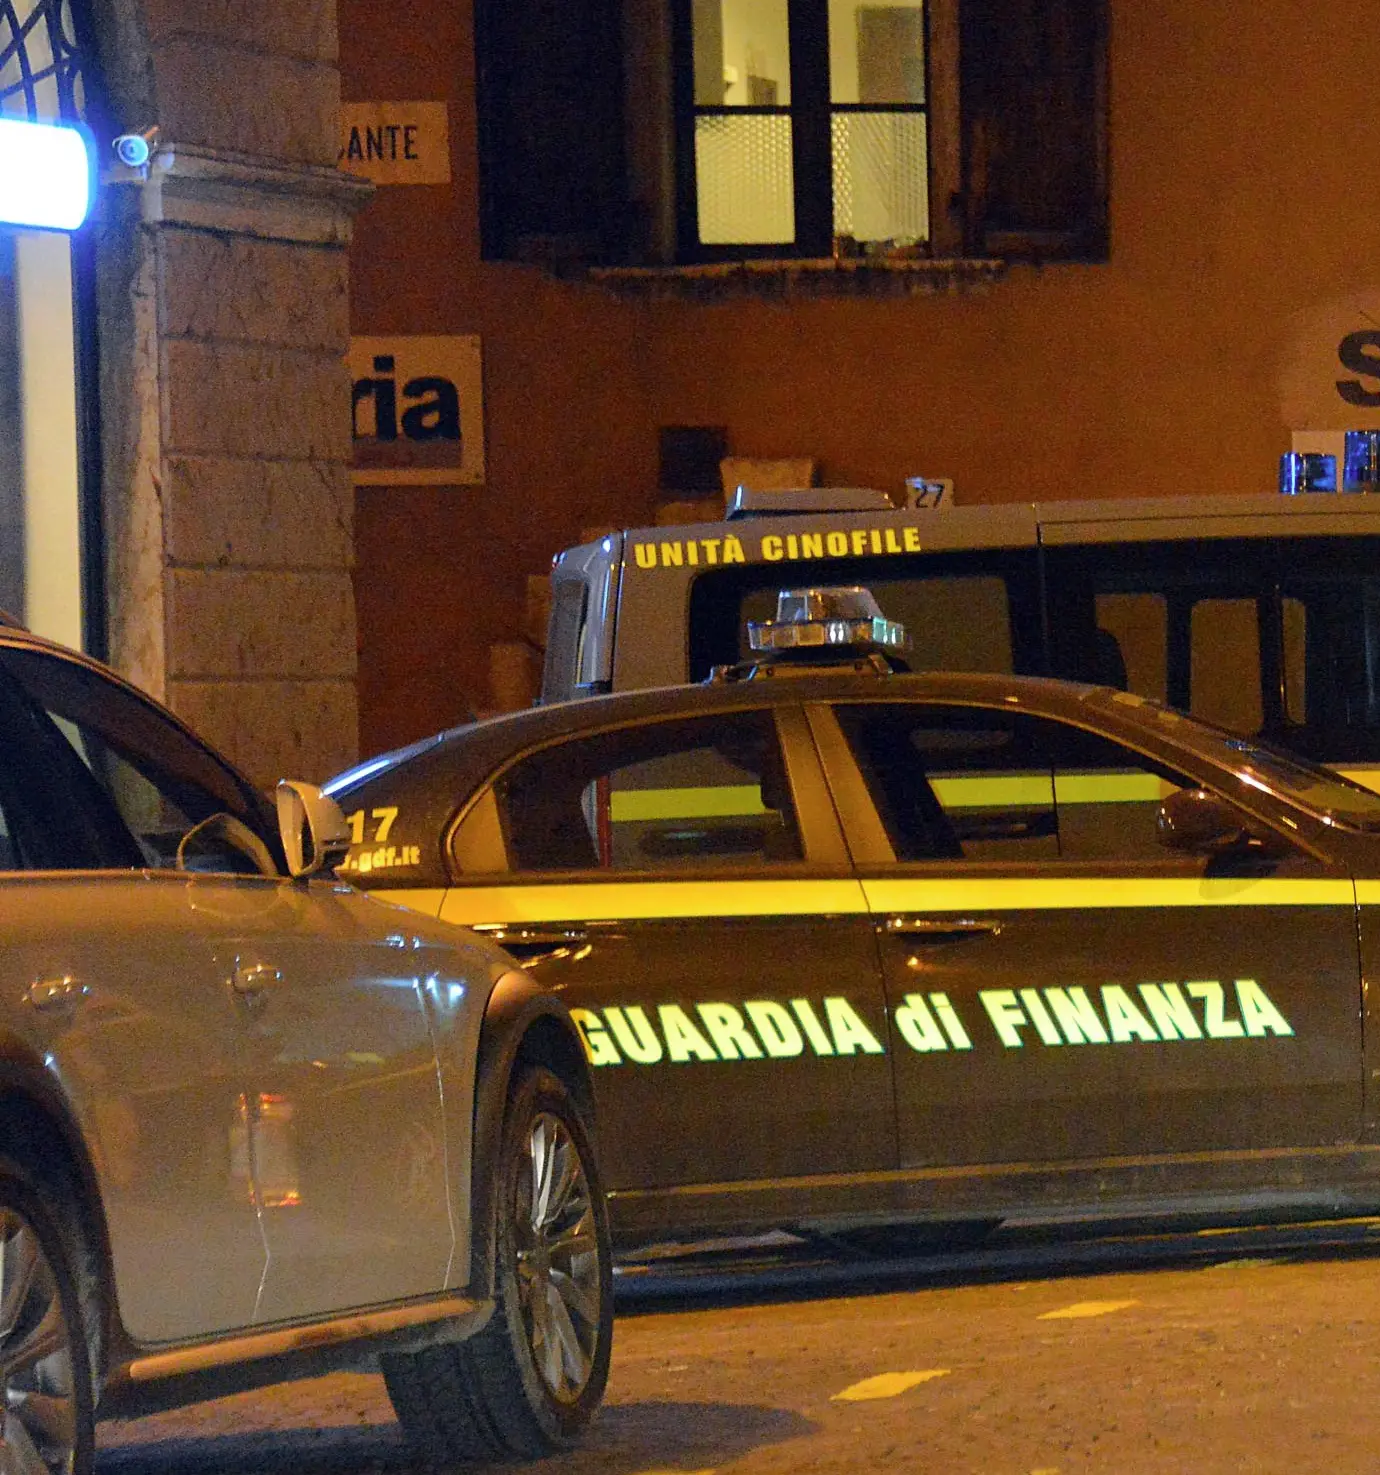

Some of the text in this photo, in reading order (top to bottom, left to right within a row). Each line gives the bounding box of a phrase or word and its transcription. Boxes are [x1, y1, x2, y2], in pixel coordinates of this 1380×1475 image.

[338, 125, 418, 160] ANTE
[914, 484, 945, 508] 27
[634, 527, 921, 569] UNITÀ CINOFILE
[569, 979, 1295, 1066] GUARDIA di FINANZA
